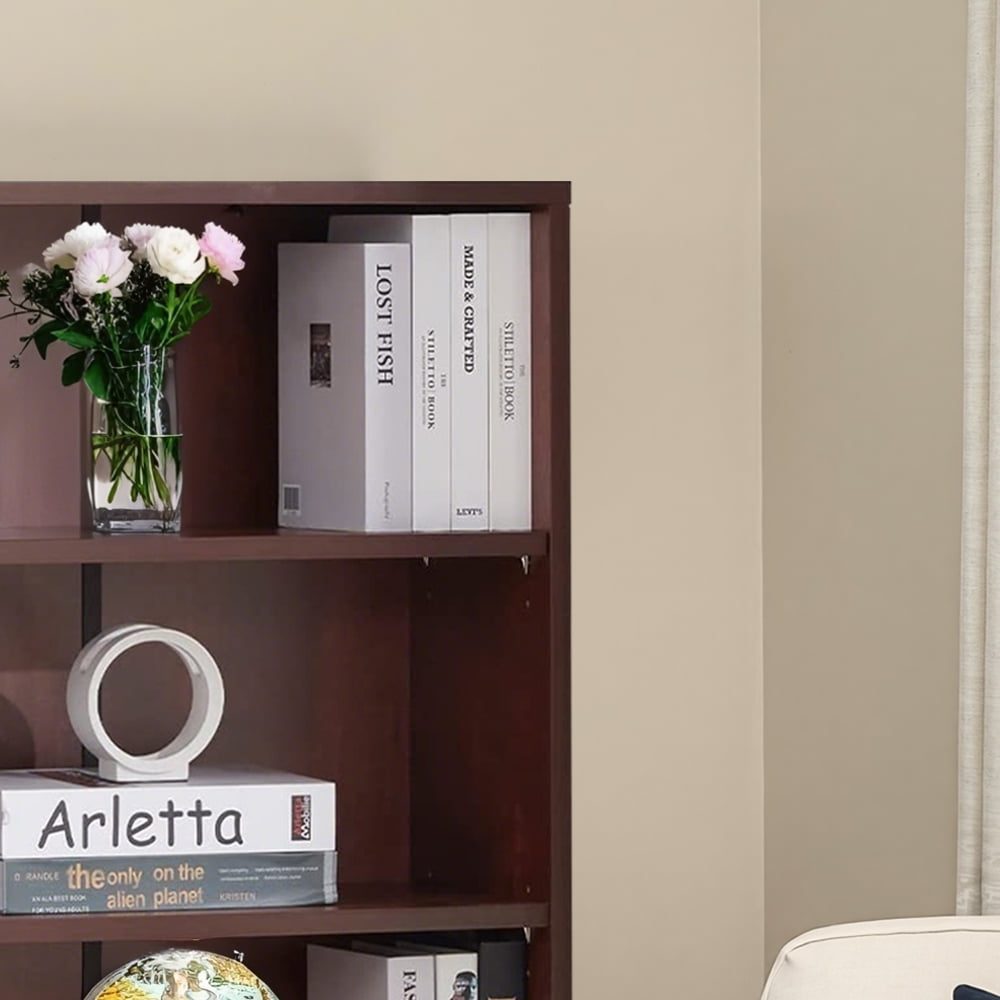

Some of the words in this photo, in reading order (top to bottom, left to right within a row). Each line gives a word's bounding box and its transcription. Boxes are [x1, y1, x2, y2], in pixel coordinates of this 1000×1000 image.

[464, 245, 474, 289] MADE
[376, 264, 392, 324] LOST
[464, 292, 474, 302] &
[377, 333, 394, 385] FISH
[464, 306, 474, 373] CRAFTED
[504, 321, 515, 379] STILETTO
[427, 396, 435, 430] BOOK
[504, 384, 515, 421] BOOK
[37, 794, 244, 850] Arletta
[66, 862, 106, 890] the
[106, 866, 143, 889] only
[152, 866, 175, 882] on
[178, 862, 205, 882] the
[106, 890, 146, 910] alien
[153, 887, 203, 909] planet
[219, 891, 257, 902] KRISTEN
